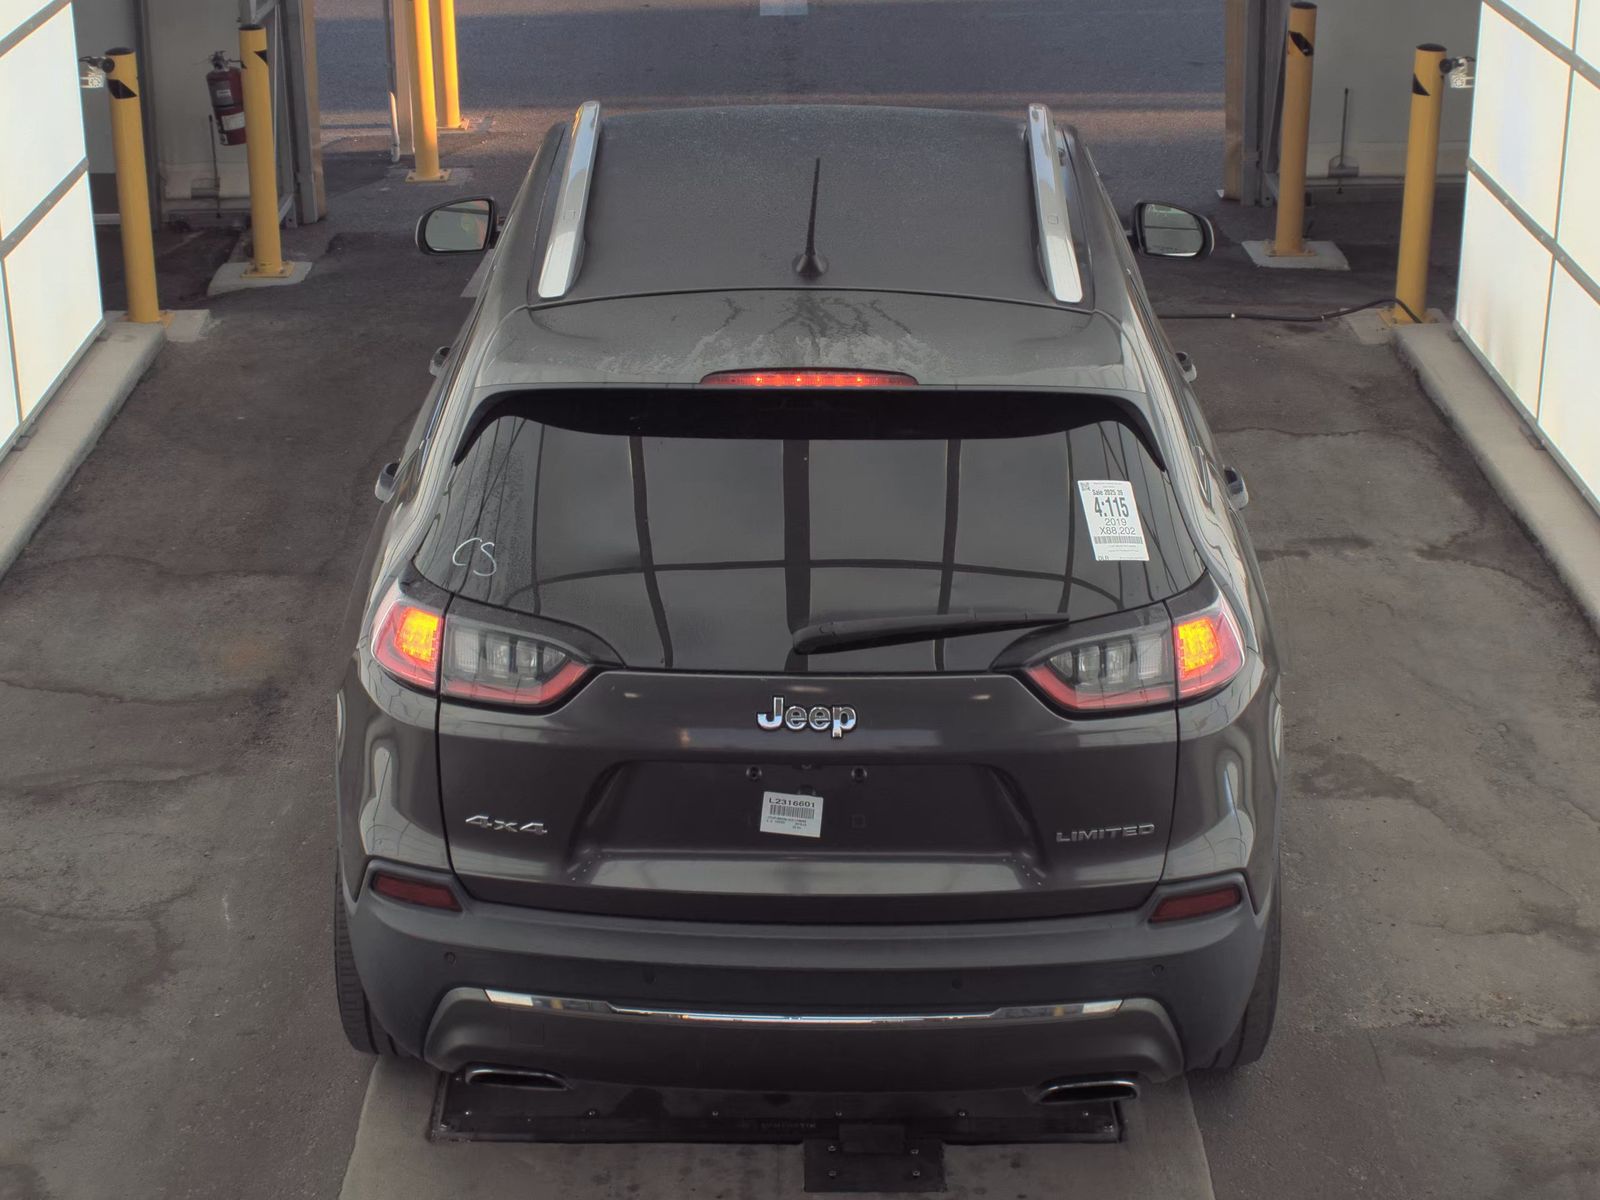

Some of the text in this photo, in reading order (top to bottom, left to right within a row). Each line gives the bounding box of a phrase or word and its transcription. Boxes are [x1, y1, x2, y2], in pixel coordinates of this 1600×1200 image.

[1094, 496, 1129, 518] 4:115
[1104, 518, 1127, 526] 2019
[757, 696, 857, 738] Jeep
[1056, 823, 1155, 842] LIMITED
